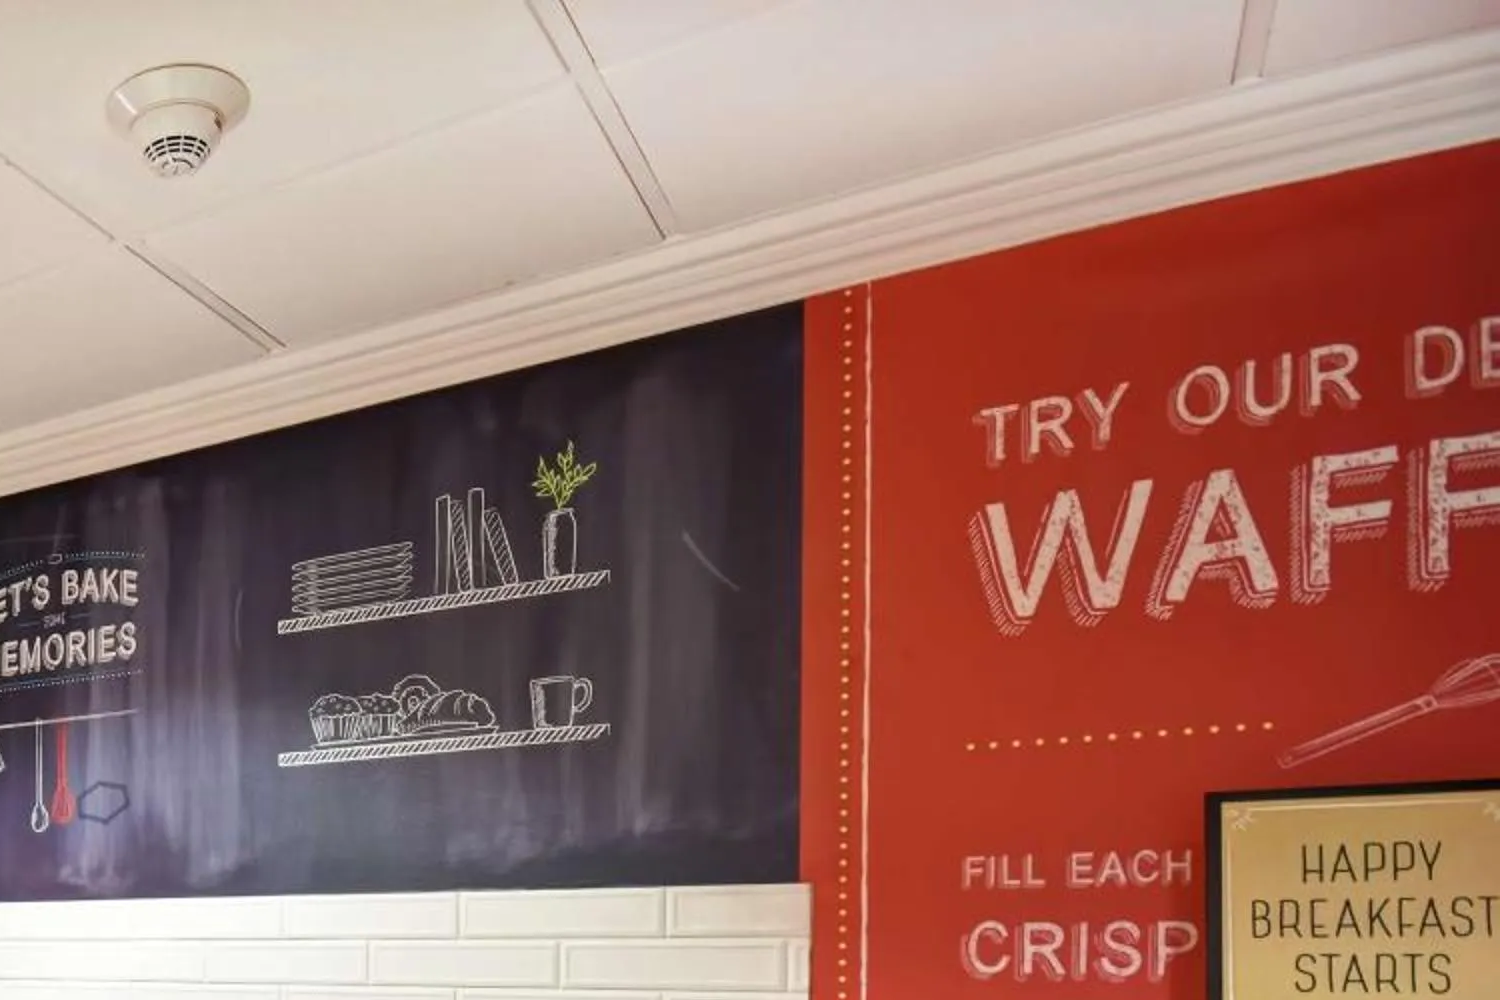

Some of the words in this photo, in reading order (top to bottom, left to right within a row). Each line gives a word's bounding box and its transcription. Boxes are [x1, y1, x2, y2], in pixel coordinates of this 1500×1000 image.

[974, 381, 1130, 465] TRY
[1169, 342, 1362, 432] OUR
[61, 567, 139, 607] BAKE
[962, 854, 1046, 890] FILL
[1067, 849, 1192, 888] EACH
[1301, 840, 1442, 884] HAPPY
[1251, 895, 1500, 939] BREAKFAST
[1294, 953, 1452, 995] STARTS
